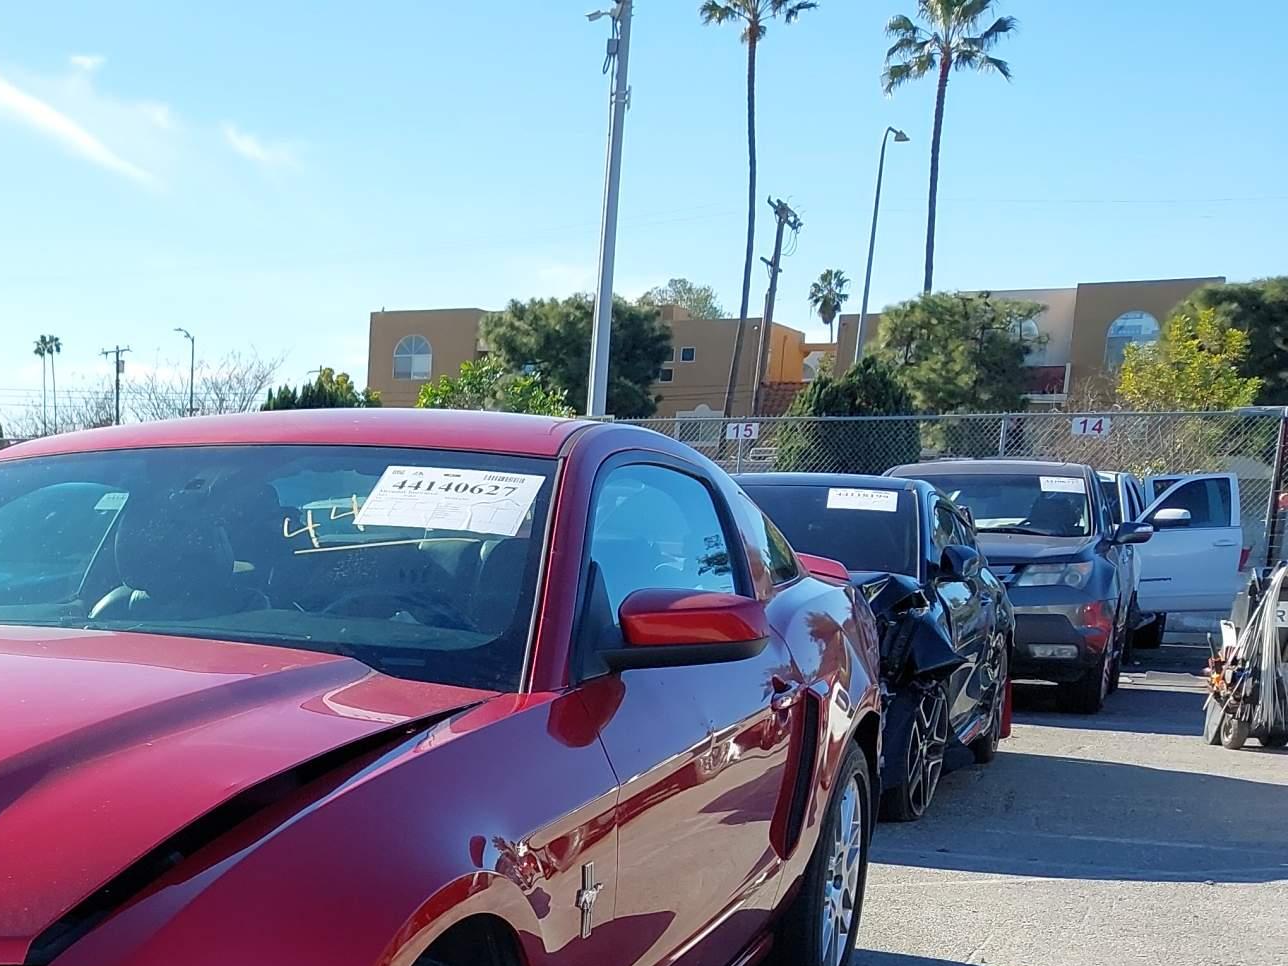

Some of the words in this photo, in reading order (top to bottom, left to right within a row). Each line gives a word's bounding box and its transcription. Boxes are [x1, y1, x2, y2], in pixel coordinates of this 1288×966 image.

[732, 423, 754, 439] 15
[1079, 418, 1104, 434] 14
[392, 479, 519, 497] 44140627
